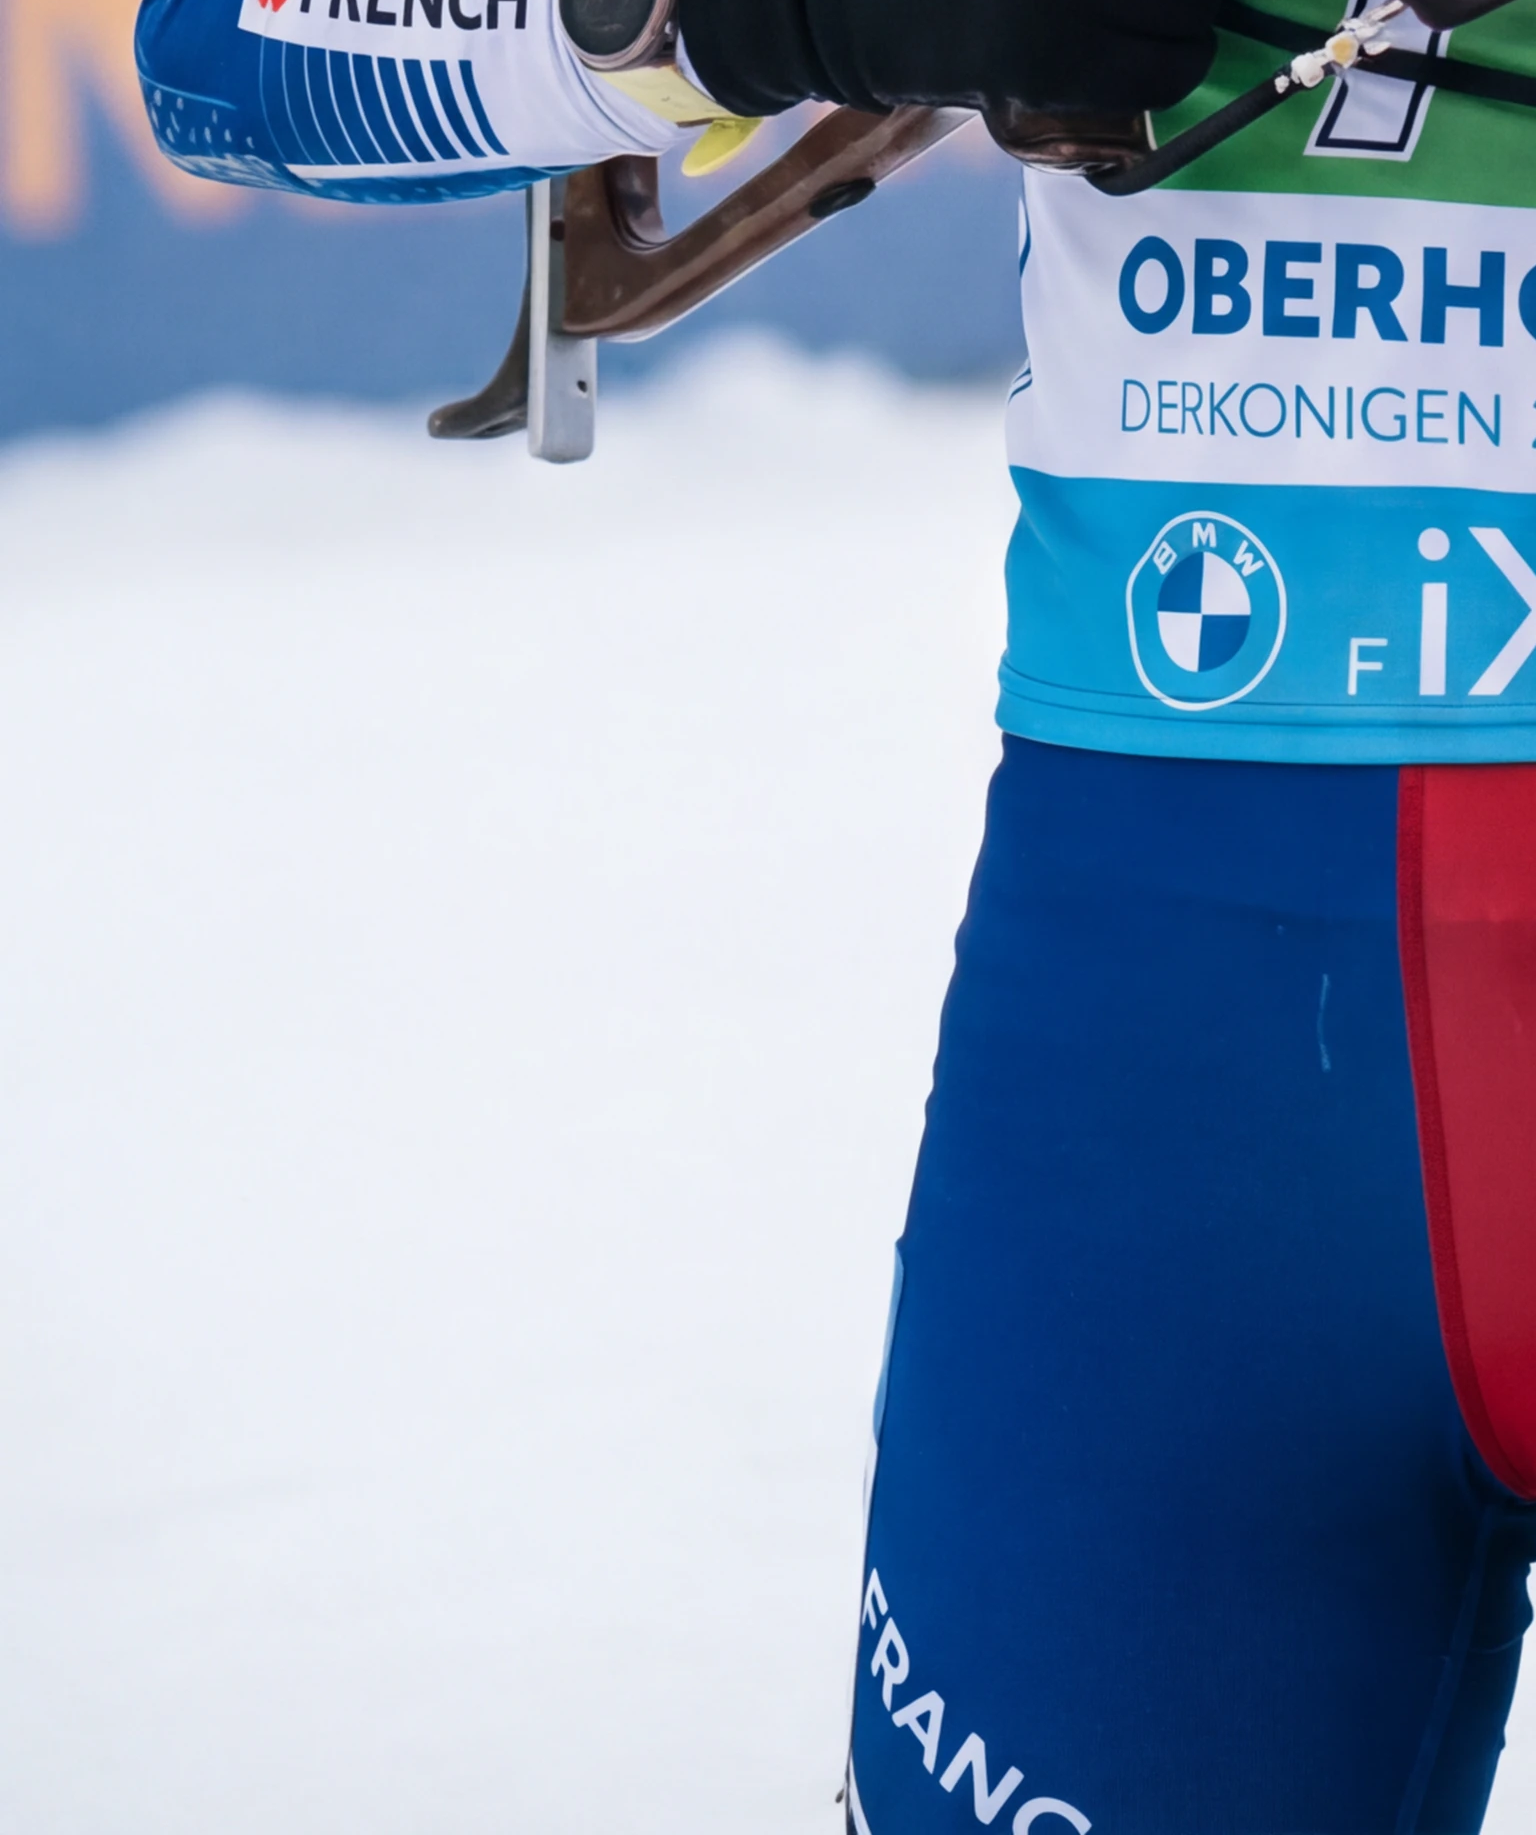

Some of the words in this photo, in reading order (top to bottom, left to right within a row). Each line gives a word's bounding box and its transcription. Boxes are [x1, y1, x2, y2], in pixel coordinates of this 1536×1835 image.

[1120, 378, 1502, 449] DERKONIGEN
[1152, 521, 1265, 577] BMW
[1346, 636, 1389, 697] F
